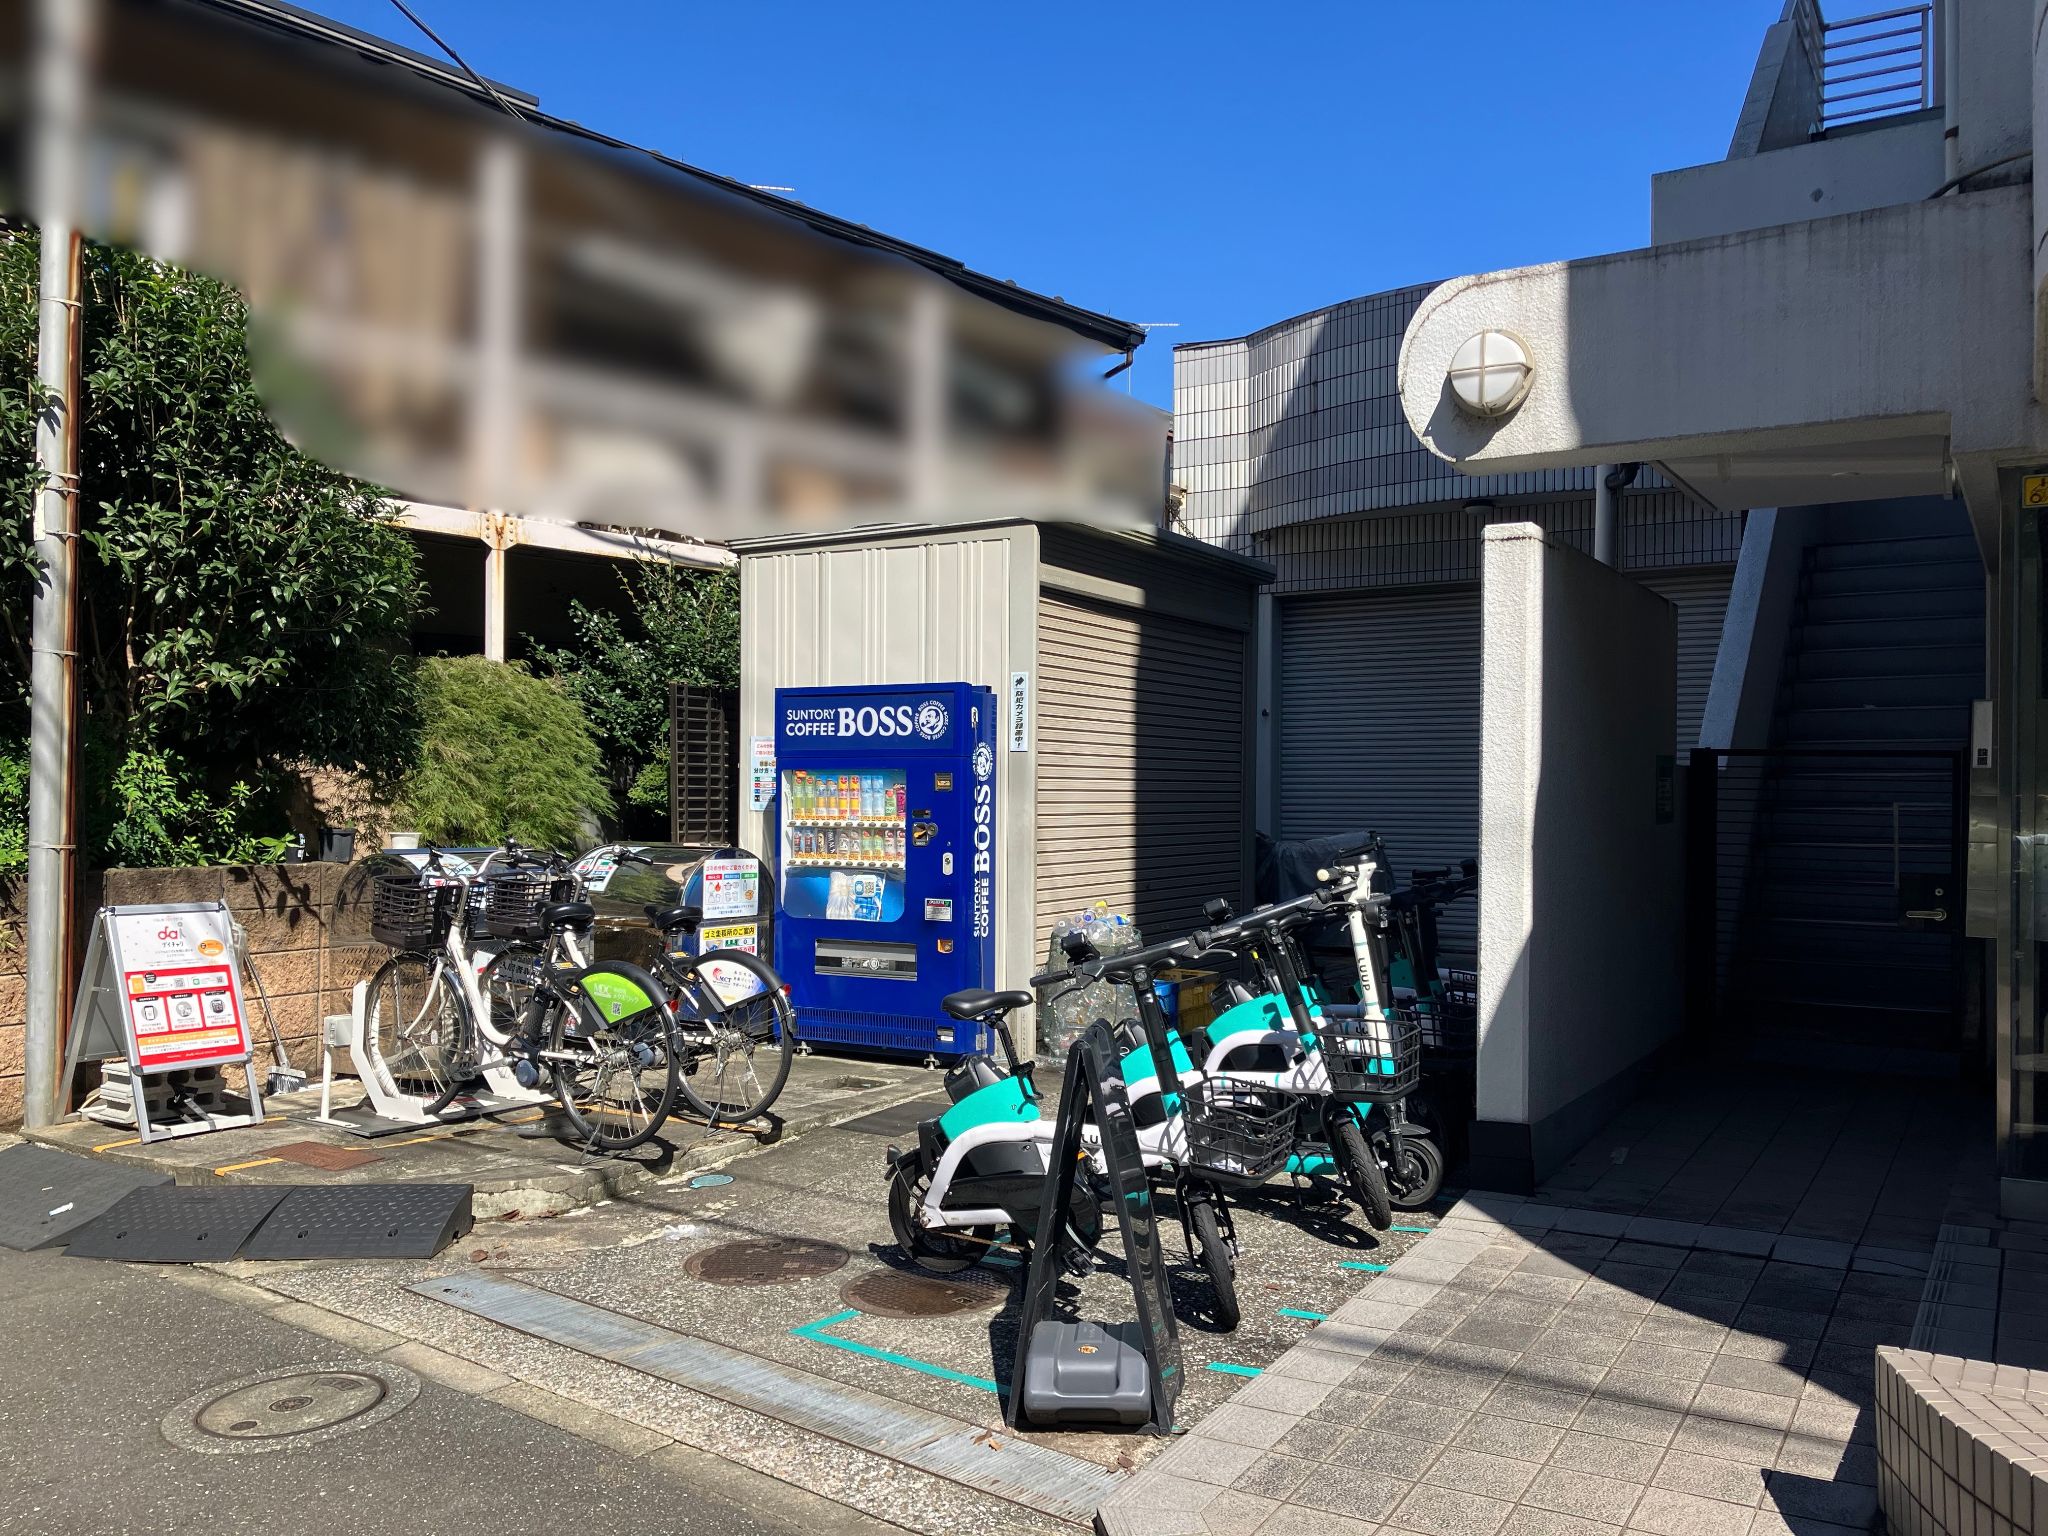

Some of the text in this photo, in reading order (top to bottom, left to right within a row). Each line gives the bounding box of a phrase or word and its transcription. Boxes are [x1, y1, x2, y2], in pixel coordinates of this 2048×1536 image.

[786, 708, 836, 720] SUNTORY
[786, 723, 836, 736] COFFEE
[837, 706, 913, 737] BOSS
[974, 784, 991, 874] BOSS
[973, 879, 981, 938] SUNTORY
[981, 878, 990, 938] COFFEE
[1357, 957, 1371, 991] LUUP
